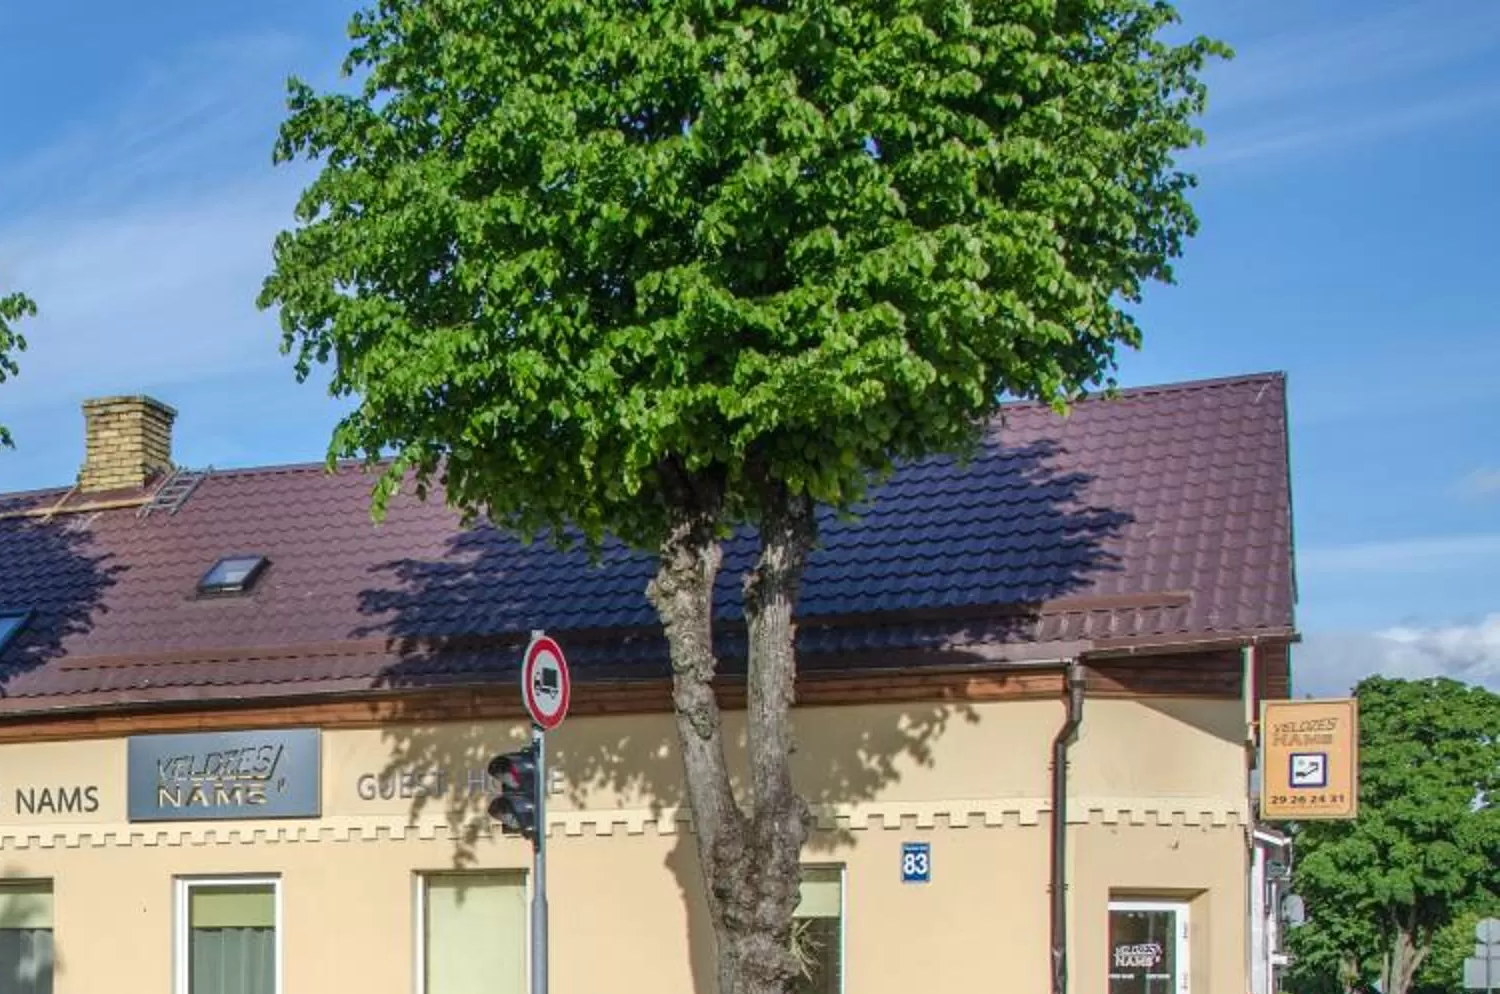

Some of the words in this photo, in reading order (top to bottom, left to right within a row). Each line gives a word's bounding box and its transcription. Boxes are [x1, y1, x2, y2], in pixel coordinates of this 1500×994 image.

[15, 785, 100, 815] NAMS
[357, 770, 446, 800] GUEST
[904, 853, 927, 875] 83
